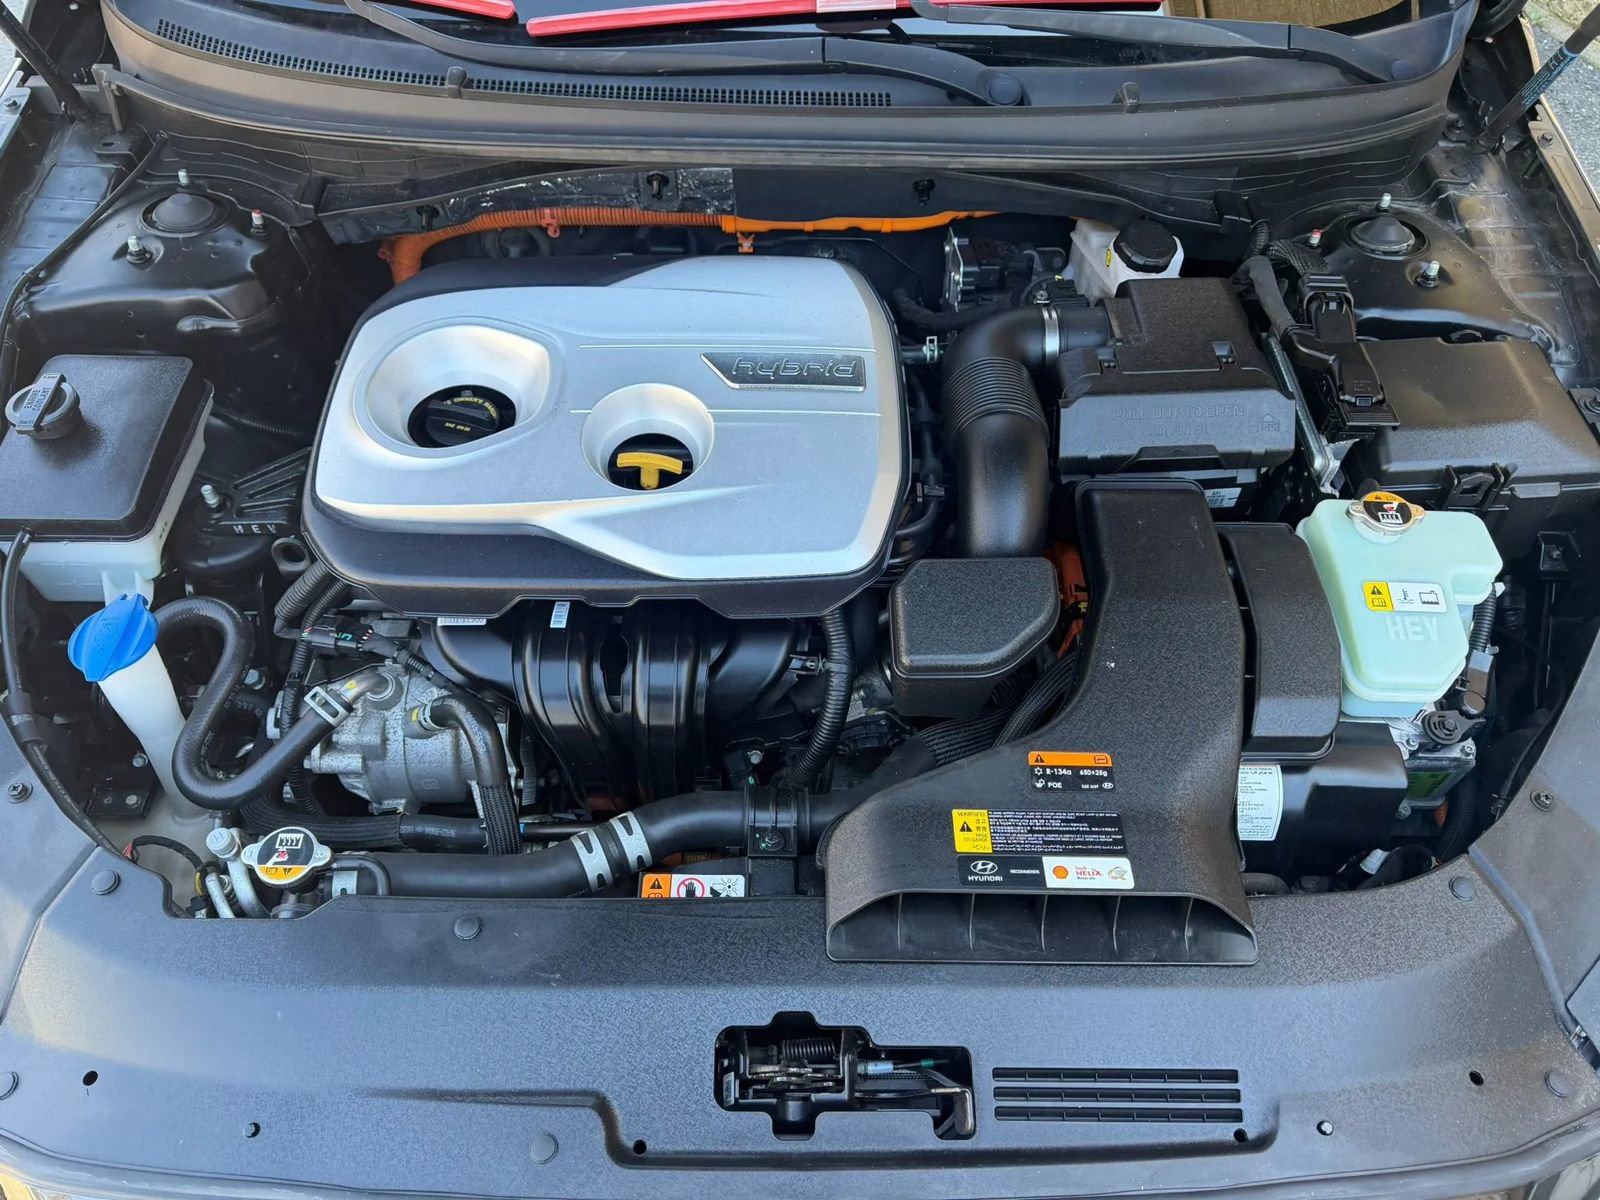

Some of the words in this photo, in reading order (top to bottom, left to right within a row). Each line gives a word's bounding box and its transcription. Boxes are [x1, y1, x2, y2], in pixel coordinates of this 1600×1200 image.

[732, 357, 856, 380] hybrid
[1112, 407, 1146, 420] PULL
[1152, 407, 1178, 419] OUT
[1183, 406, 1202, 418] TO
[1207, 405, 1244, 417] OPEN
[233, 524, 276, 534] HEV
[1385, 614, 1440, 640] HEV
[1076, 868, 1103, 877] HELIX
